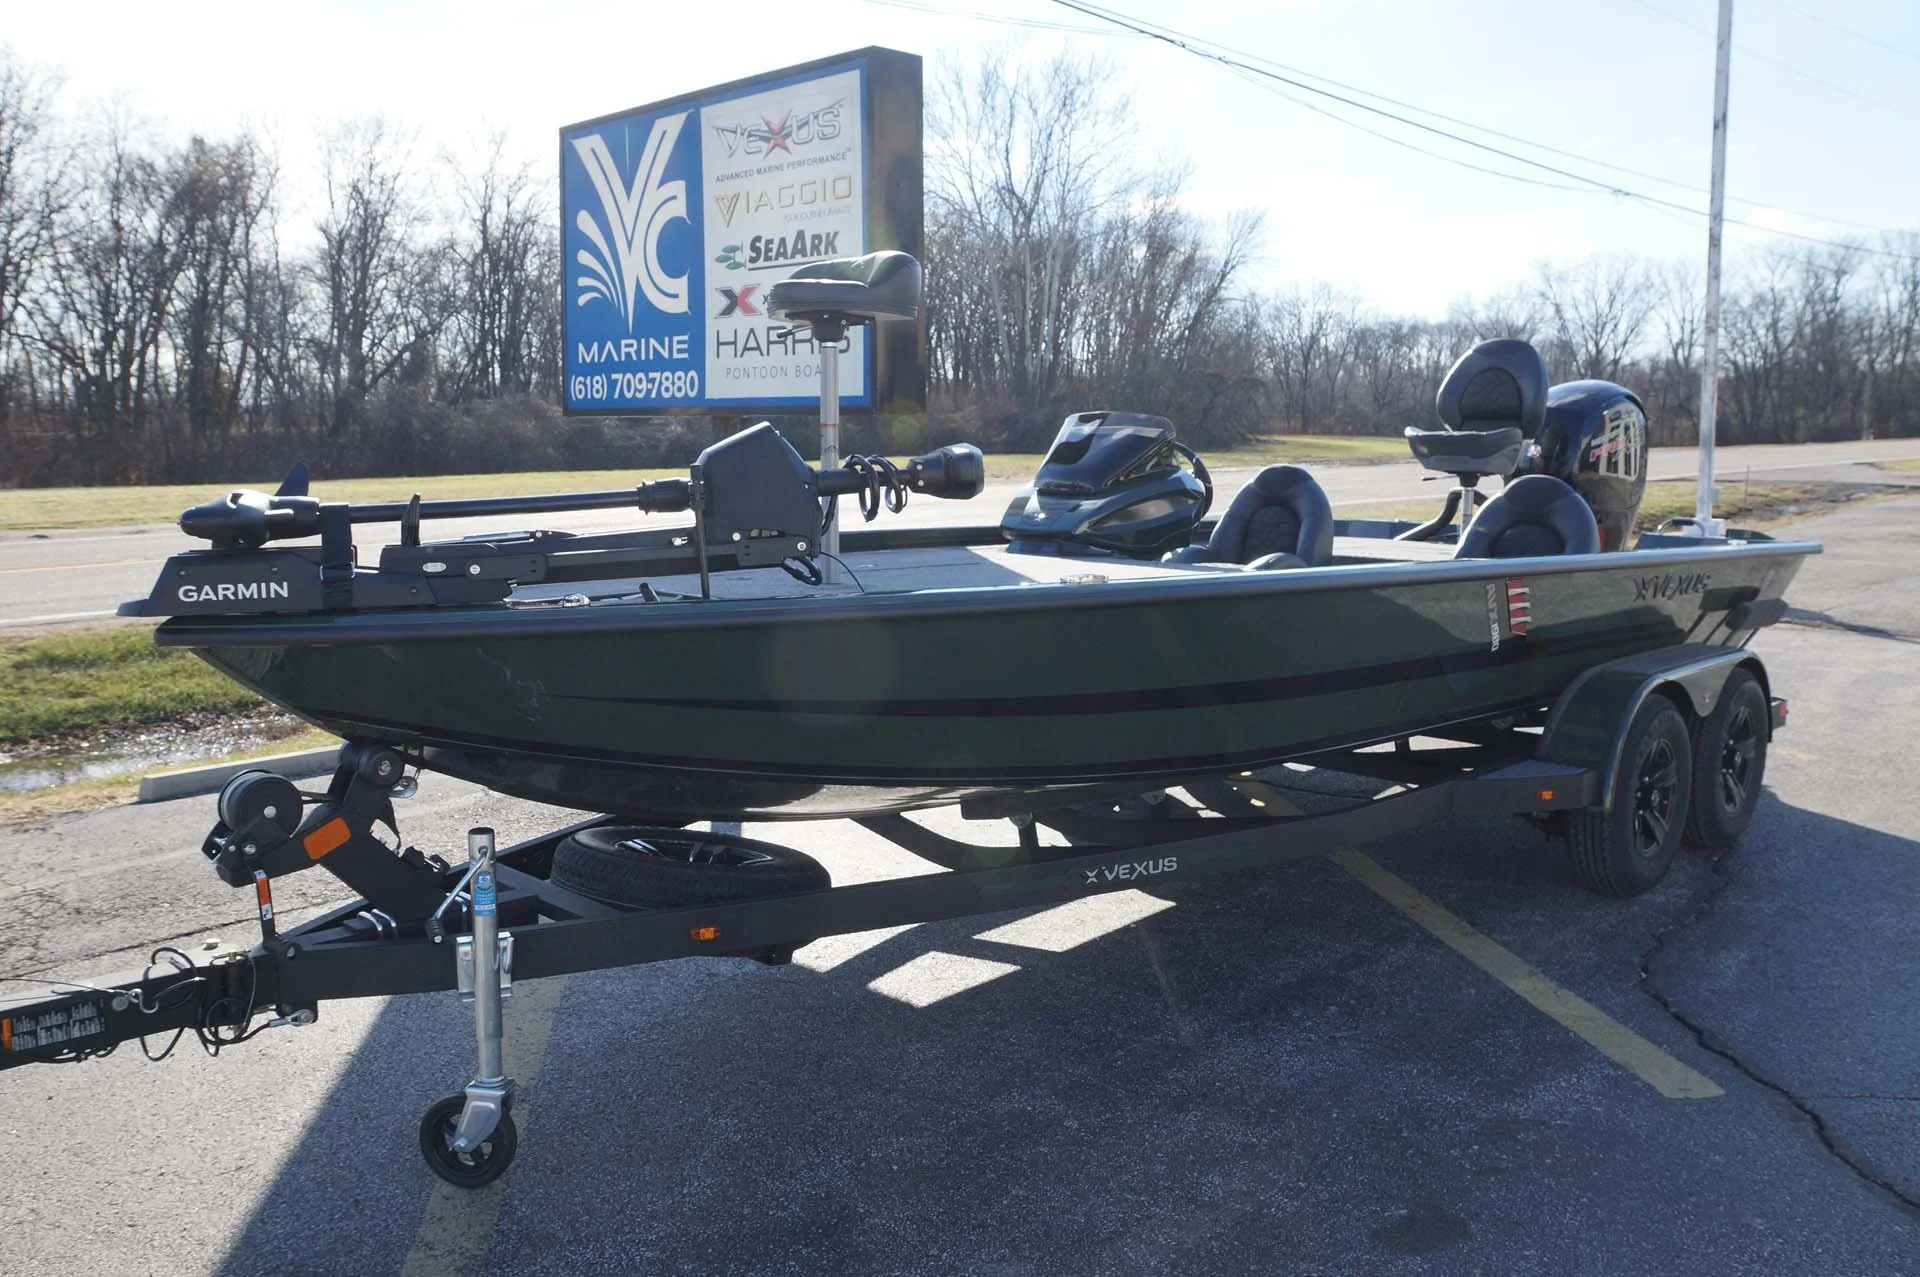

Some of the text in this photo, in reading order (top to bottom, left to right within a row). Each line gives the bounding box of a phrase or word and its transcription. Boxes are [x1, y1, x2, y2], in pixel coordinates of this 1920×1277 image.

[712, 100, 846, 160] VEXUS
[716, 151, 848, 183] ADVANCED MARINE PERFORMANCE
[714, 175, 852, 228] VIAGGIO
[577, 334, 689, 364] MARINE
[571, 370, 699, 400] (618) 709-7880
[725, 365, 788, 380] PONTOON
[178, 581, 288, 602] GARMIN
[1101, 857, 1178, 881] VEXUS
